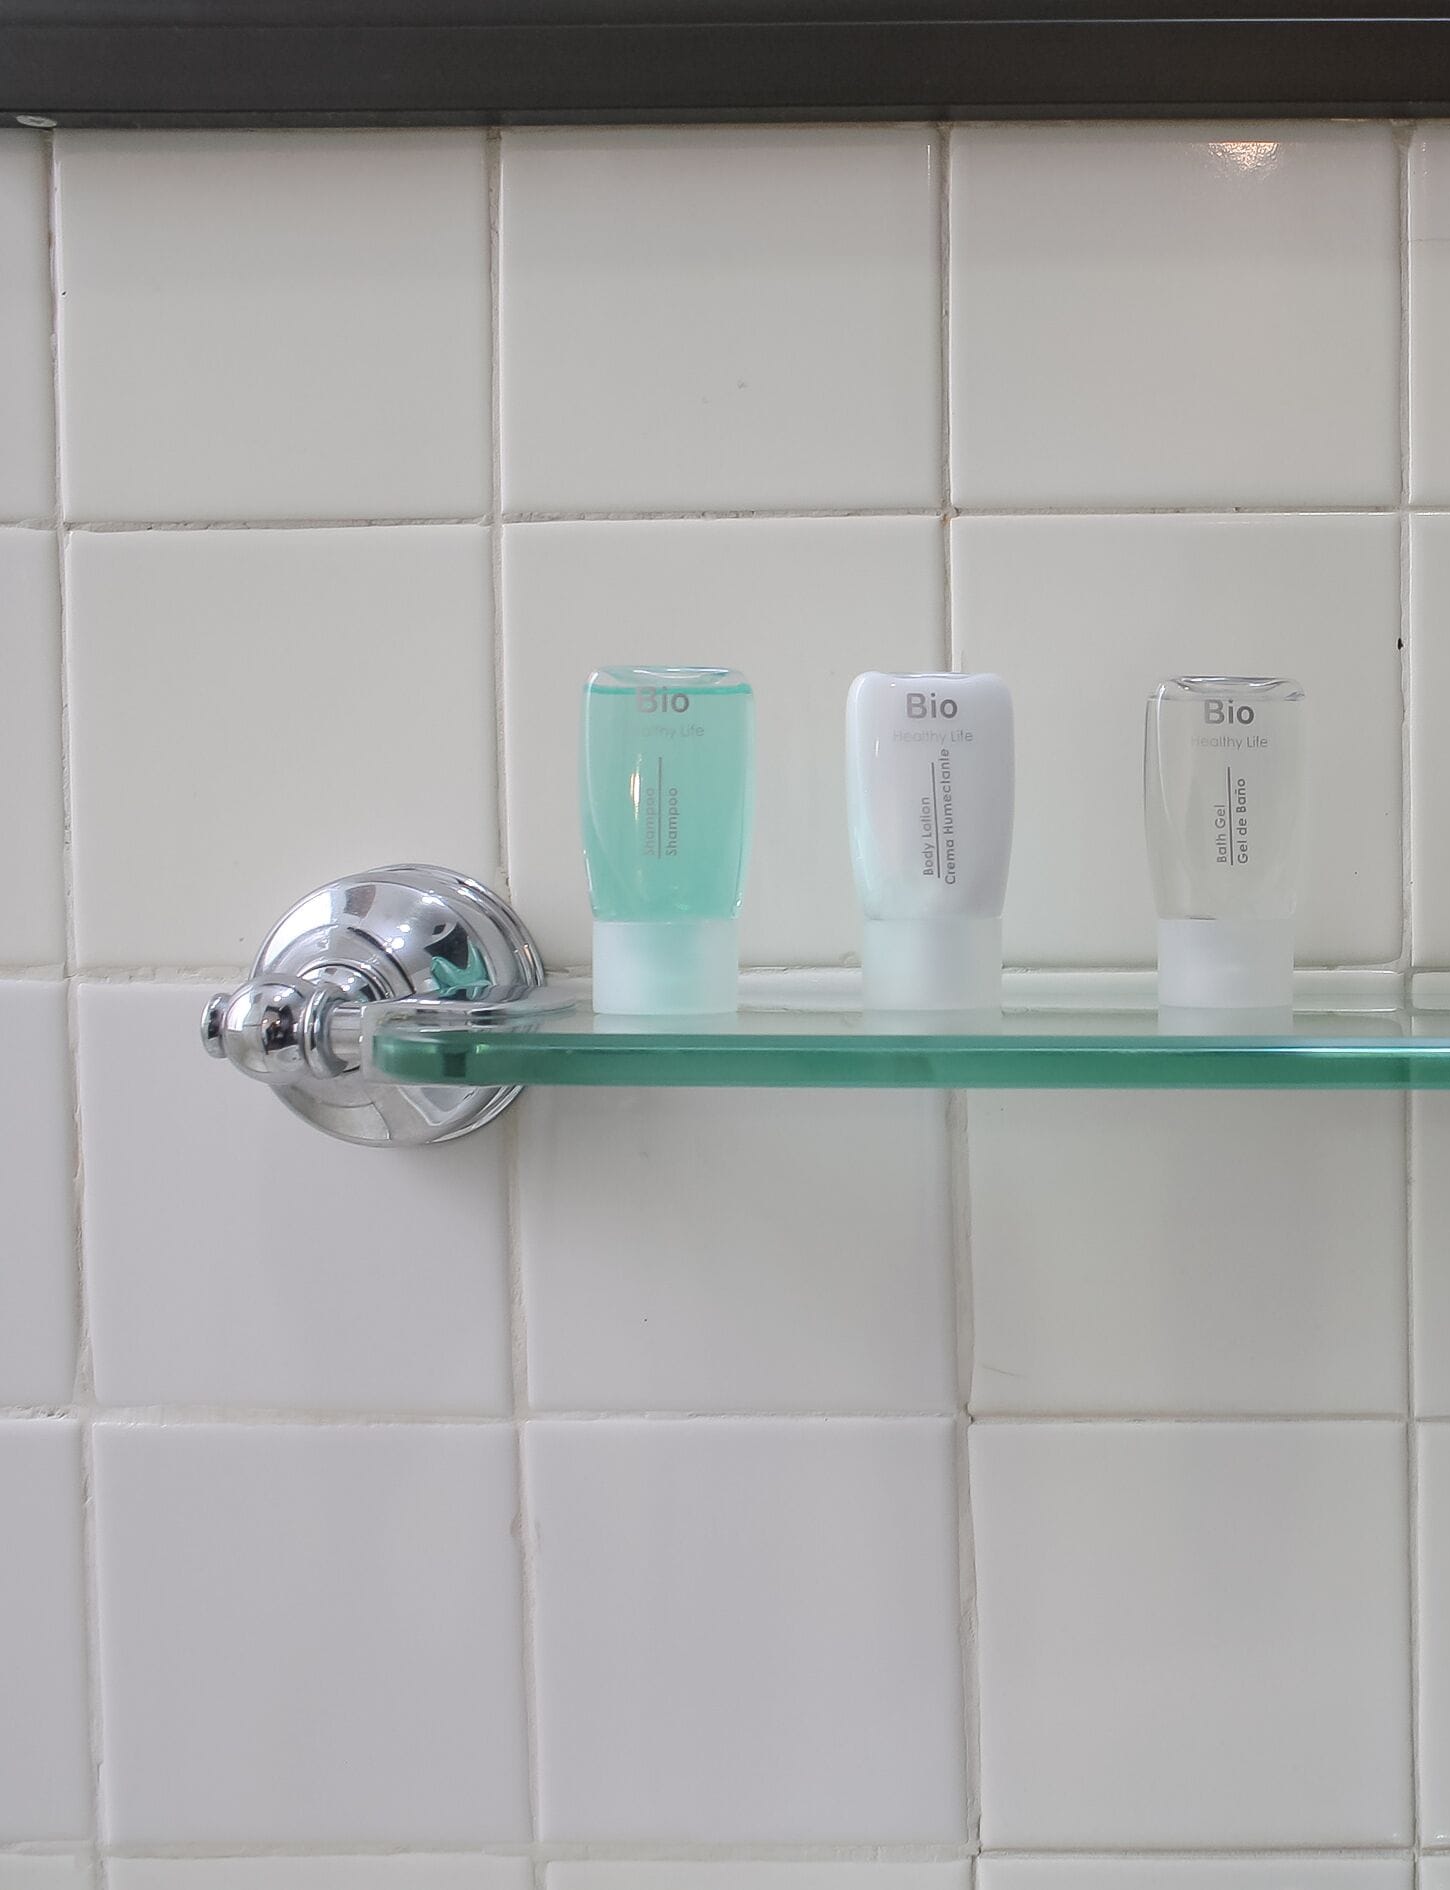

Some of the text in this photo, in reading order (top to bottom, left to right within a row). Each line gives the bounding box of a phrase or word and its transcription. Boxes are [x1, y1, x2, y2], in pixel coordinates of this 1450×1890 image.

[636, 686, 690, 713] Bio
[906, 692, 958, 719] Bio
[1204, 698, 1255, 725] Bio
[893, 729, 974, 745] Healthy Life
[1191, 736, 1269, 750] Healthy Life
[665, 787, 681, 857] Shampoo
[920, 796, 935, 876] Body Lotion
[939, 748, 956, 885] Crema Humectante
[1213, 804, 1228, 863] Bath Gel
[1234, 777, 1249, 864] Gel de Baño
